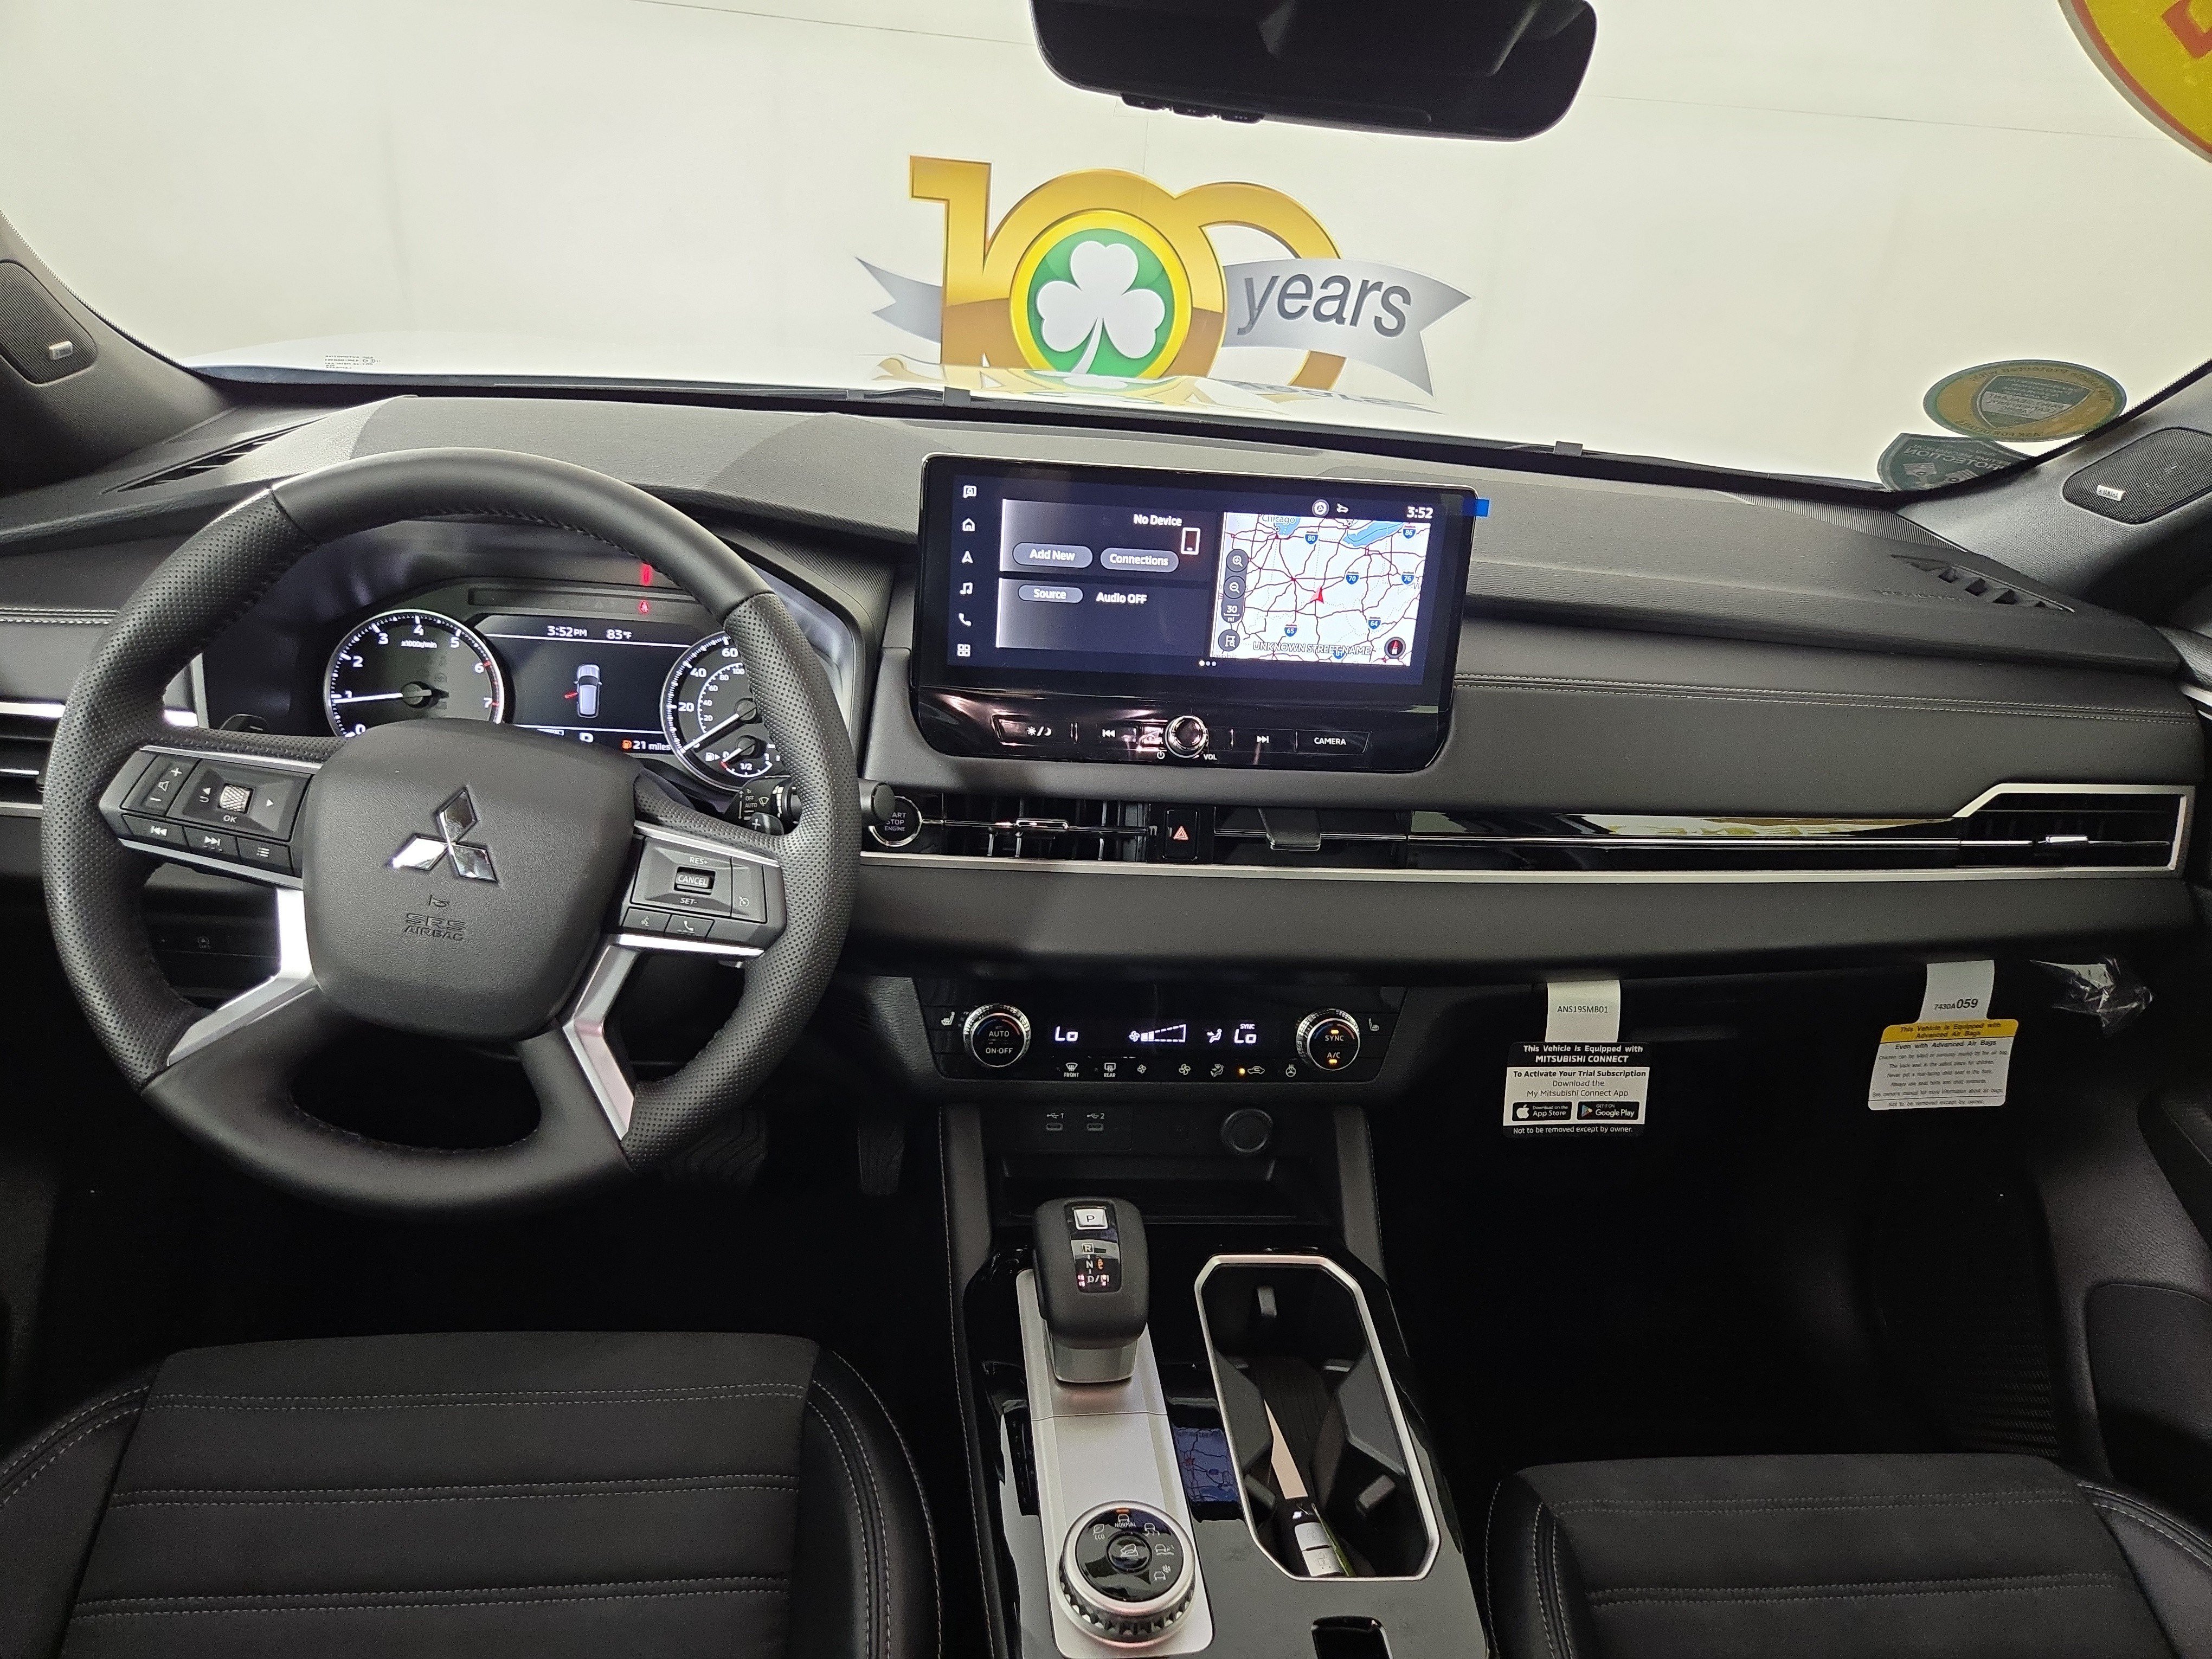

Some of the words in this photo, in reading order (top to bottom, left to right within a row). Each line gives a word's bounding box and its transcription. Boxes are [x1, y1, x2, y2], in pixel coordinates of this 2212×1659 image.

[1237, 273, 1412, 338] years
[1406, 506, 1433, 519] 3:52
[1133, 513, 1148, 524] No
[1150, 515, 1182, 526] Device
[1261, 515, 1297, 524] Chicago
[1029, 549, 1050, 560] Add
[1052, 549, 1076, 561] New
[1109, 553, 1169, 566] Connections
[1033, 588, 1067, 600] Source
[1096, 592, 1127, 603] Audio
[1127, 594, 1148, 605] OFF
[1227, 605, 1238, 613] 30
[414, 624, 424, 636] 4
[606, 629, 632, 639] 83°F
[378, 633, 389, 644] 3
[450, 636, 460, 648] 5
[722, 647, 738, 658] 60
[1253, 641, 1306, 653] UNKNOWN
[1307, 644, 1341, 654] STREET
[1342, 645, 1372, 655] NAME
[352, 655, 363, 667] 2
[474, 663, 484, 673] 6
[690, 668, 707, 678] 40
[345, 690, 352, 698] 1
[483, 697, 492, 708] 7
[678, 702, 695, 712] 20
[355, 724, 366, 735] 0
[632, 740, 646, 750] 21
[648, 742, 671, 751] miles
[1314, 737, 1347, 746] CAMERA
[223, 814, 237, 824] OK
[689, 857, 709, 865] RES+
[678, 874, 709, 886] CANCEL
[679, 897, 698, 906] SET-
[406, 913, 467, 931] SRS
[403, 924, 464, 942] AIRBAG
[1557, 1005, 1609, 1013] ANS19SMB01
[1953, 1023, 1985, 1031] Equipped
[1054, 1026, 1079, 1042] Lo
[1233, 1028, 1257, 1044] Lo
[1584, 1045, 1622, 1053] Equipped
[1535, 1055, 1586, 1063] MITSUBISHI
[1597, 1070, 1647, 1078] Subscription
[1527, 1090, 1538, 1098] My
[1613, 1090, 1629, 1098] App
[1595, 1109, 1620, 1117] Google
[1621, 1109, 1635, 1118] Play
[1086, 1214, 1095, 1223] P
[1084, 1244, 1092, 1252] R
[1085, 1259, 1094, 1269] N
